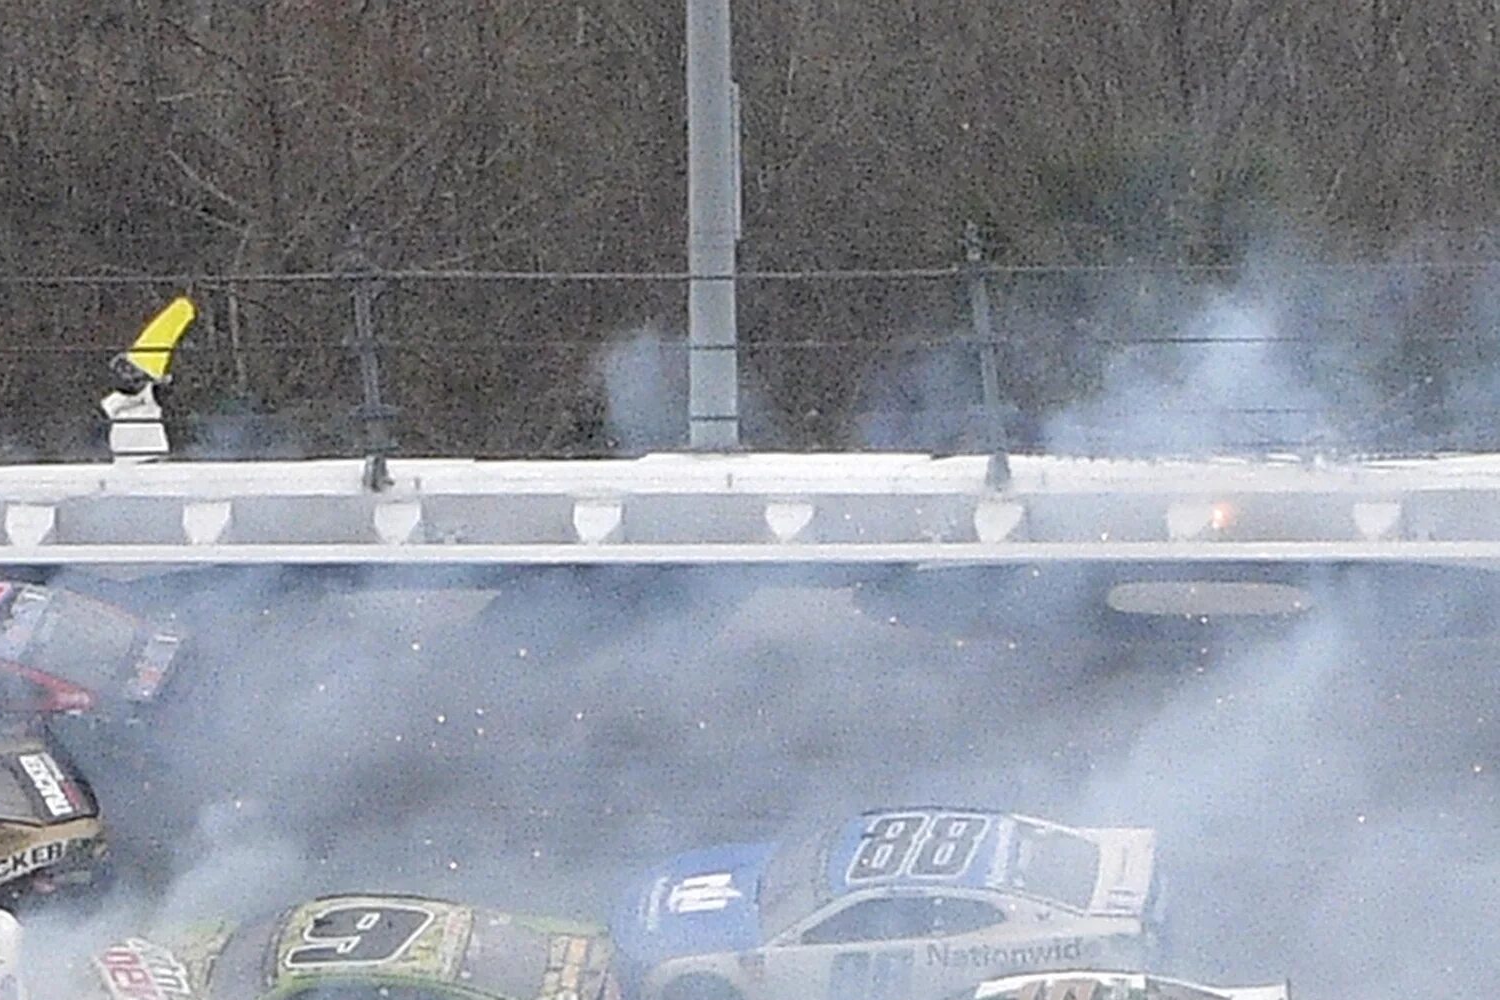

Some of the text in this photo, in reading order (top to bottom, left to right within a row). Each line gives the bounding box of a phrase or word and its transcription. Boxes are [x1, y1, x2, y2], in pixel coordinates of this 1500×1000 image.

[845, 812, 991, 883] 88
[286, 901, 437, 969] 9
[925, 936, 1085, 972] Nationwid
